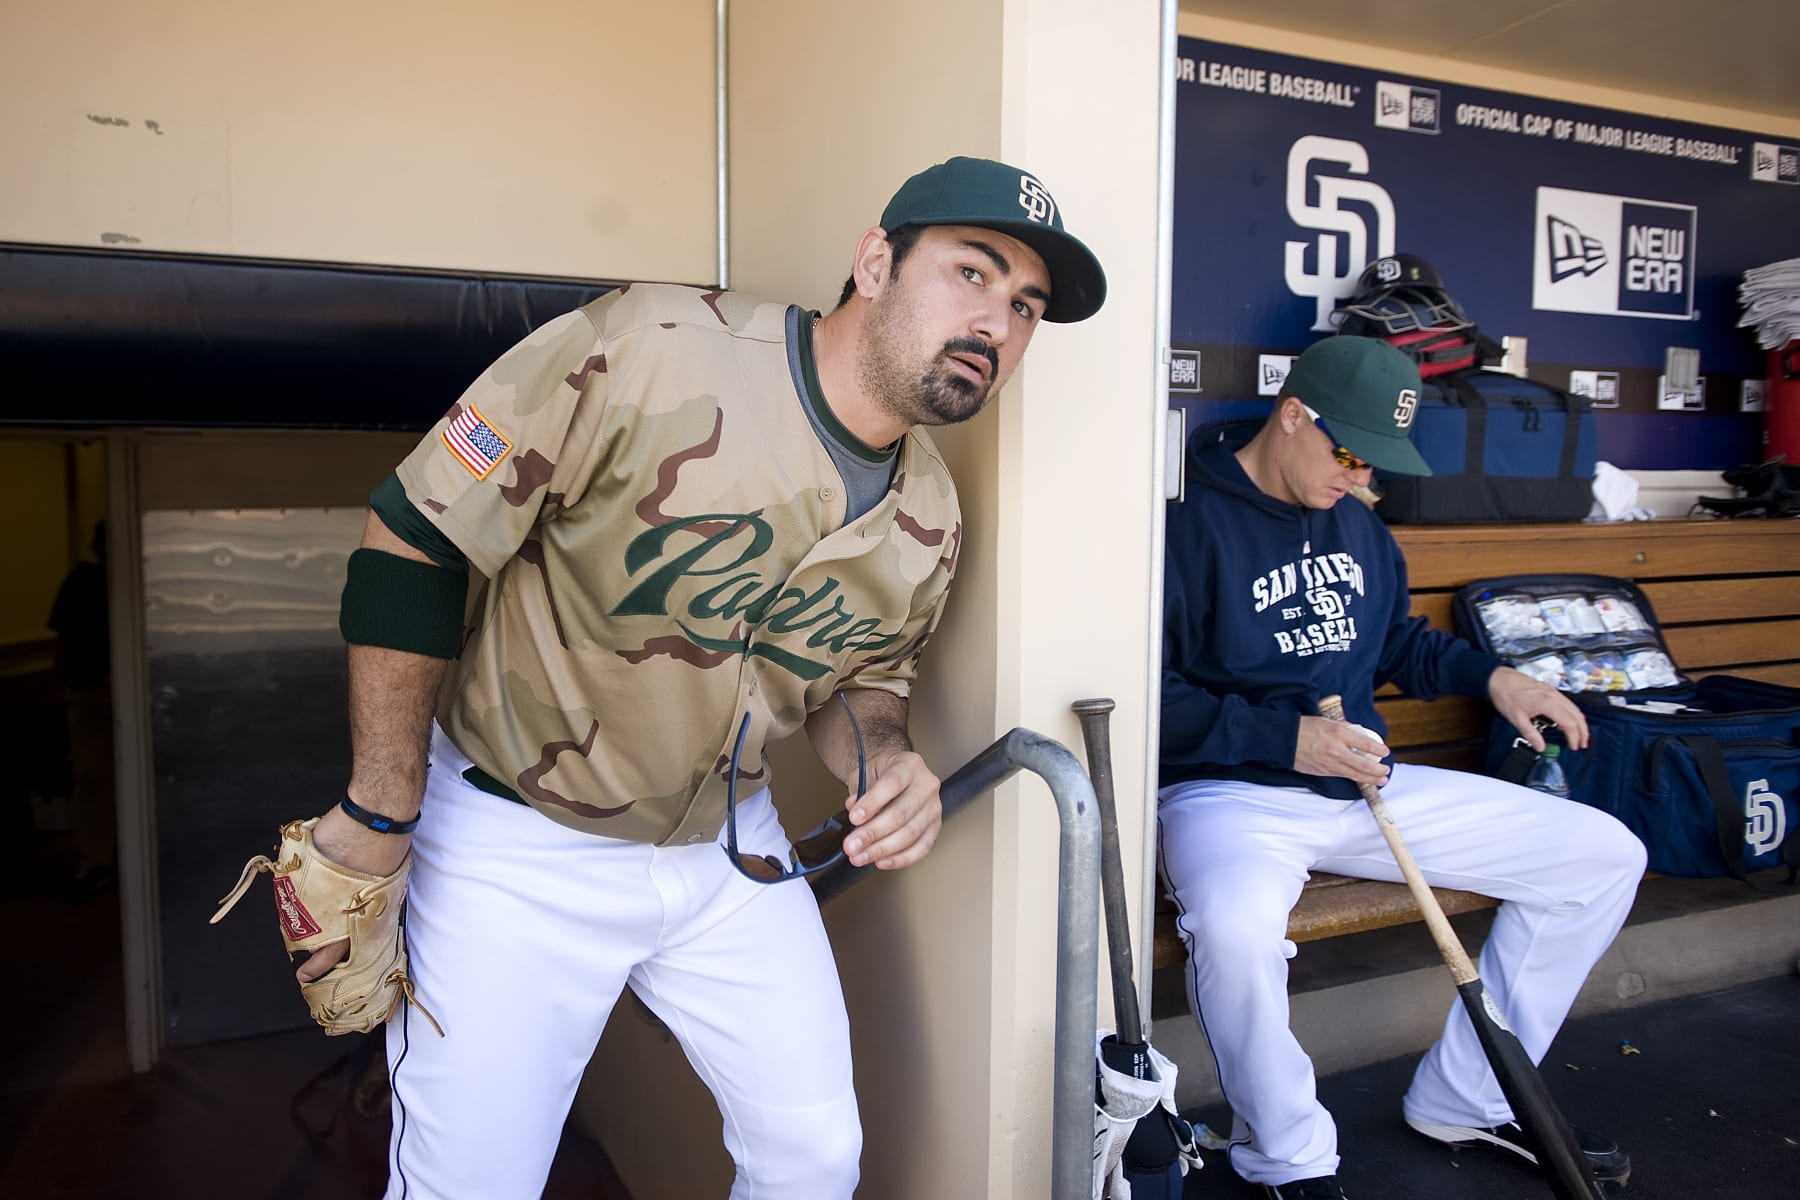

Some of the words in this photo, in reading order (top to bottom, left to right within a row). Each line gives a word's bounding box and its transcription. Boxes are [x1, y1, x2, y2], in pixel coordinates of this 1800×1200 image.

[1199, 61, 1266, 93] LEAGUE
[1269, 72, 1355, 108] BASEBALL
[1456, 103, 1521, 133] OFFICIAL
[1522, 113, 1552, 137] CAP
[1554, 119, 1574, 140] OF
[1574, 123, 1625, 148] MAJOR
[1625, 129, 1676, 156] LEAGUE
[1675, 138, 1739, 165] BASEBALL
[1627, 225, 1685, 262] NEW
[1626, 258, 1683, 294] ERA
[1171, 358, 1196, 371] NEW
[1171, 370, 1196, 384] ERA
[1252, 562, 1297, 612] SAN
